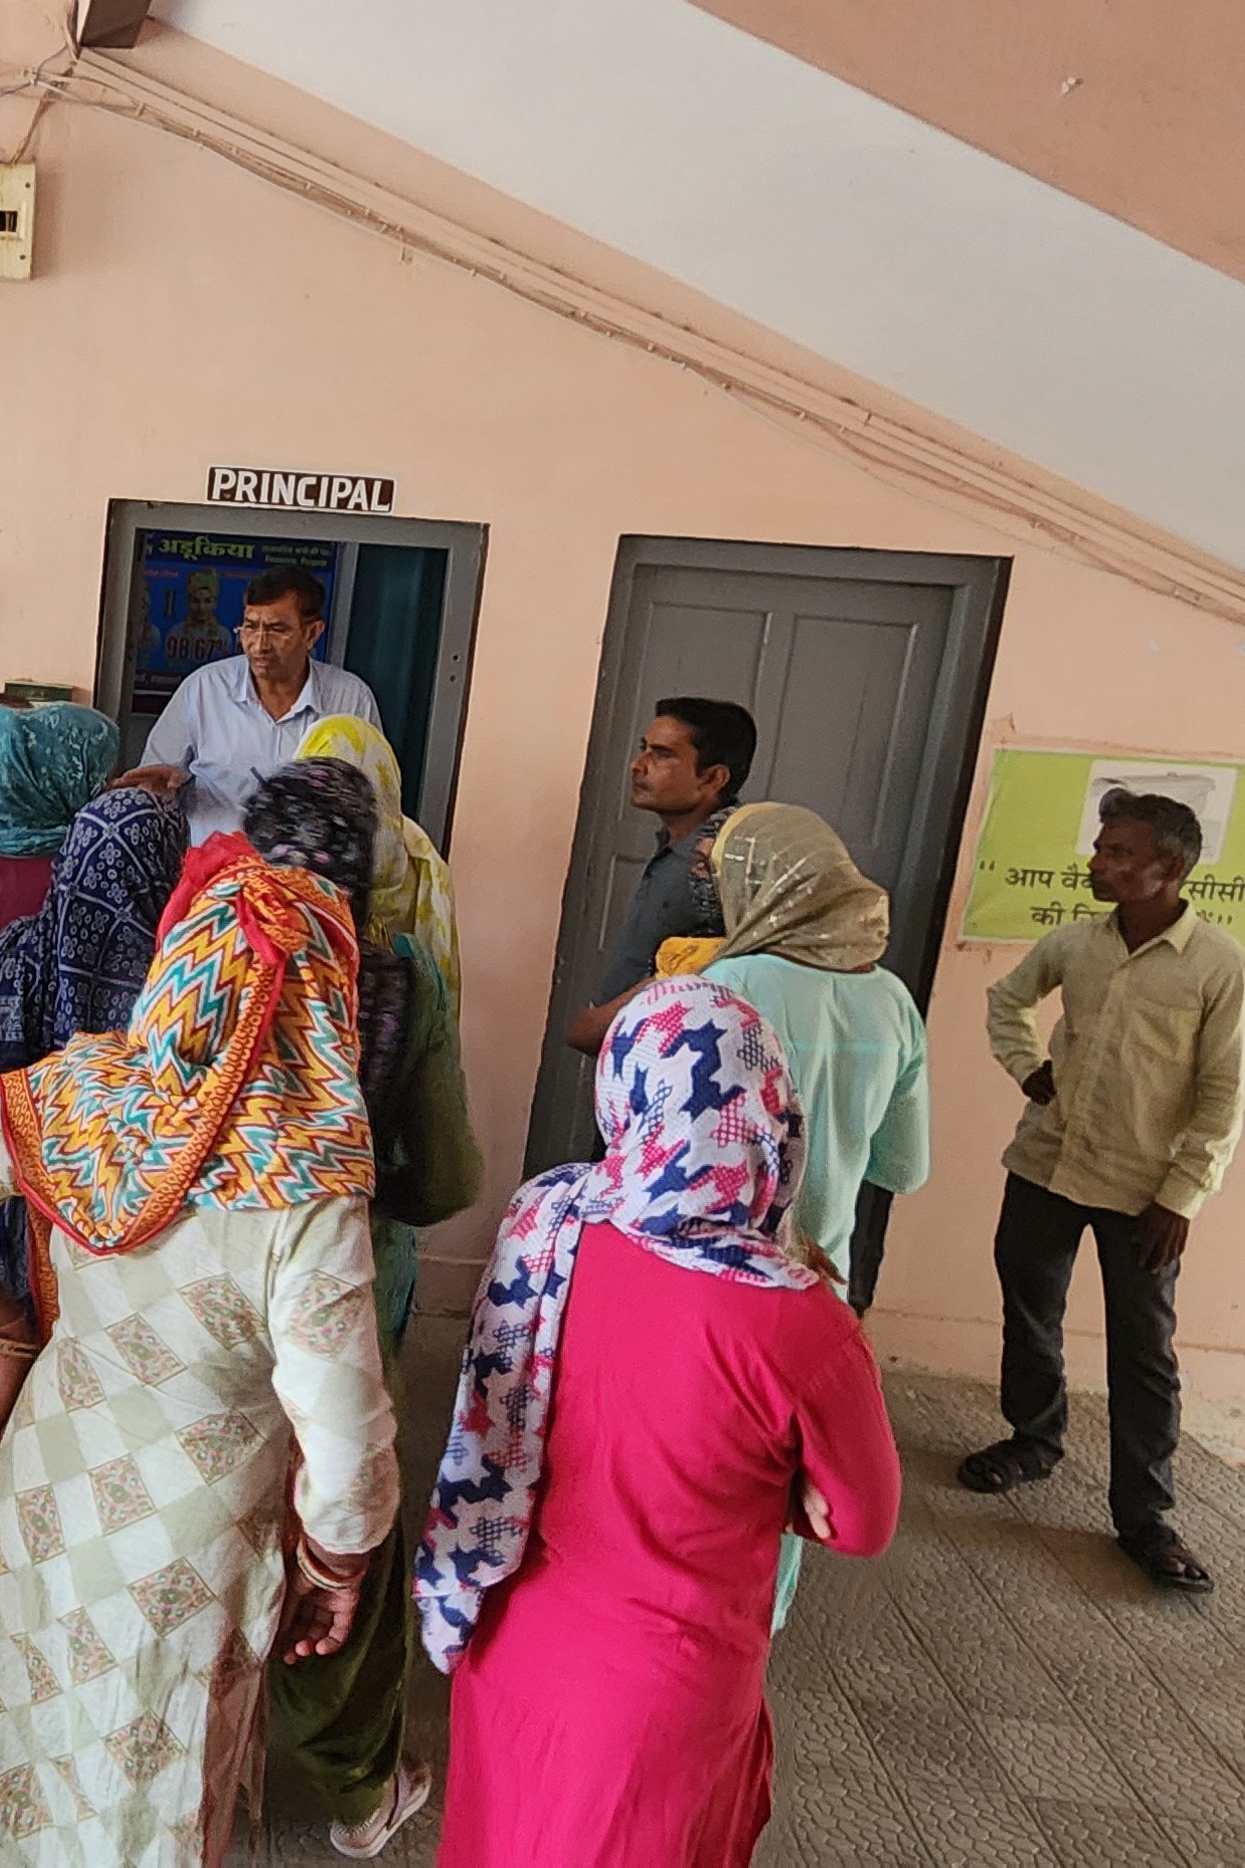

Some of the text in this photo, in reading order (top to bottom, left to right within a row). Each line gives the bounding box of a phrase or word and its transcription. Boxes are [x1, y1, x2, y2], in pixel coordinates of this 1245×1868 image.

[210, 466, 392, 512] PRINCIPAL
[1005, 867, 1055, 889] आप
[1030, 901, 1066, 926] की
